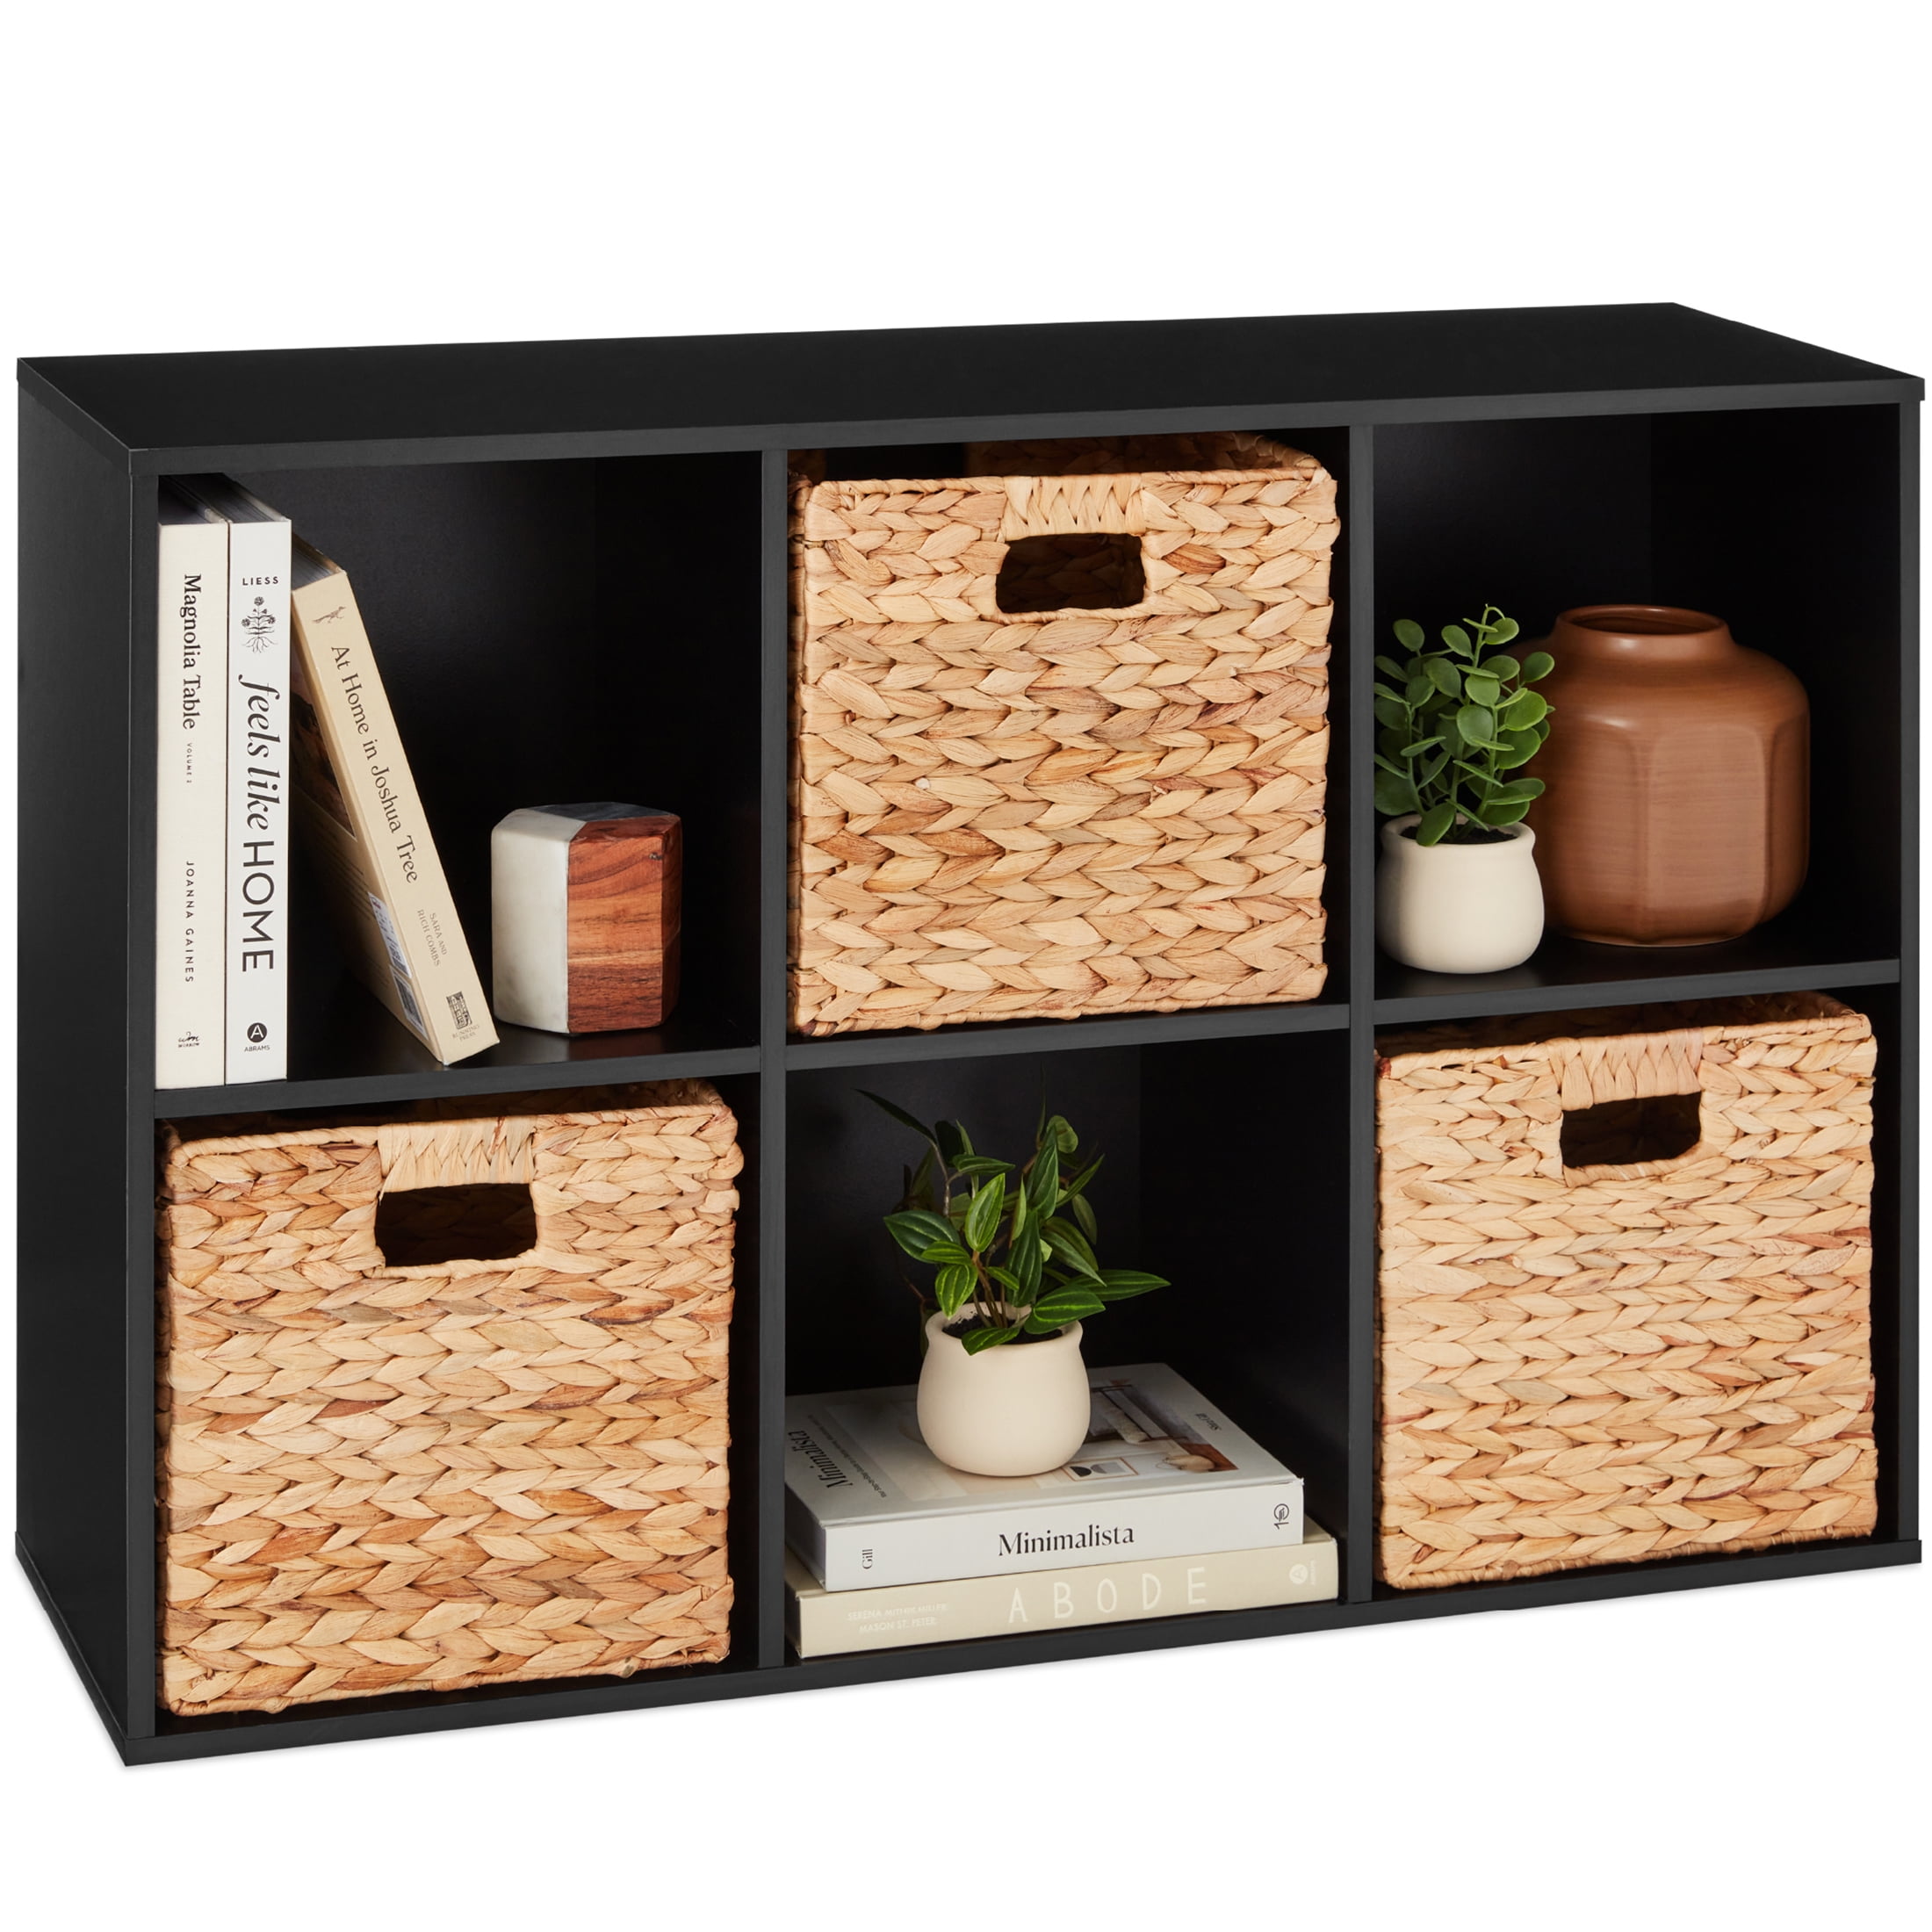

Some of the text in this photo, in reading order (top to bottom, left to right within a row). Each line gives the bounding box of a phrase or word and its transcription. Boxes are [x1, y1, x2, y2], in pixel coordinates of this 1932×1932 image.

[242, 576, 279, 586] LIESS
[180, 573, 202, 730] Magnolia Table
[330, 645, 418, 883] At Home in Joshua Tree
[238, 674, 281, 972] feels like HOME
[184, 861, 195, 982] JOANNA GAINES
[417, 909, 441, 967] RICH COMBS
[429, 912, 447, 955] SARA AND
[788, 1431, 854, 1489] Minimalista
[861, 1549, 873, 1569] Gill
[998, 1525, 1135, 1556] Minimalista
